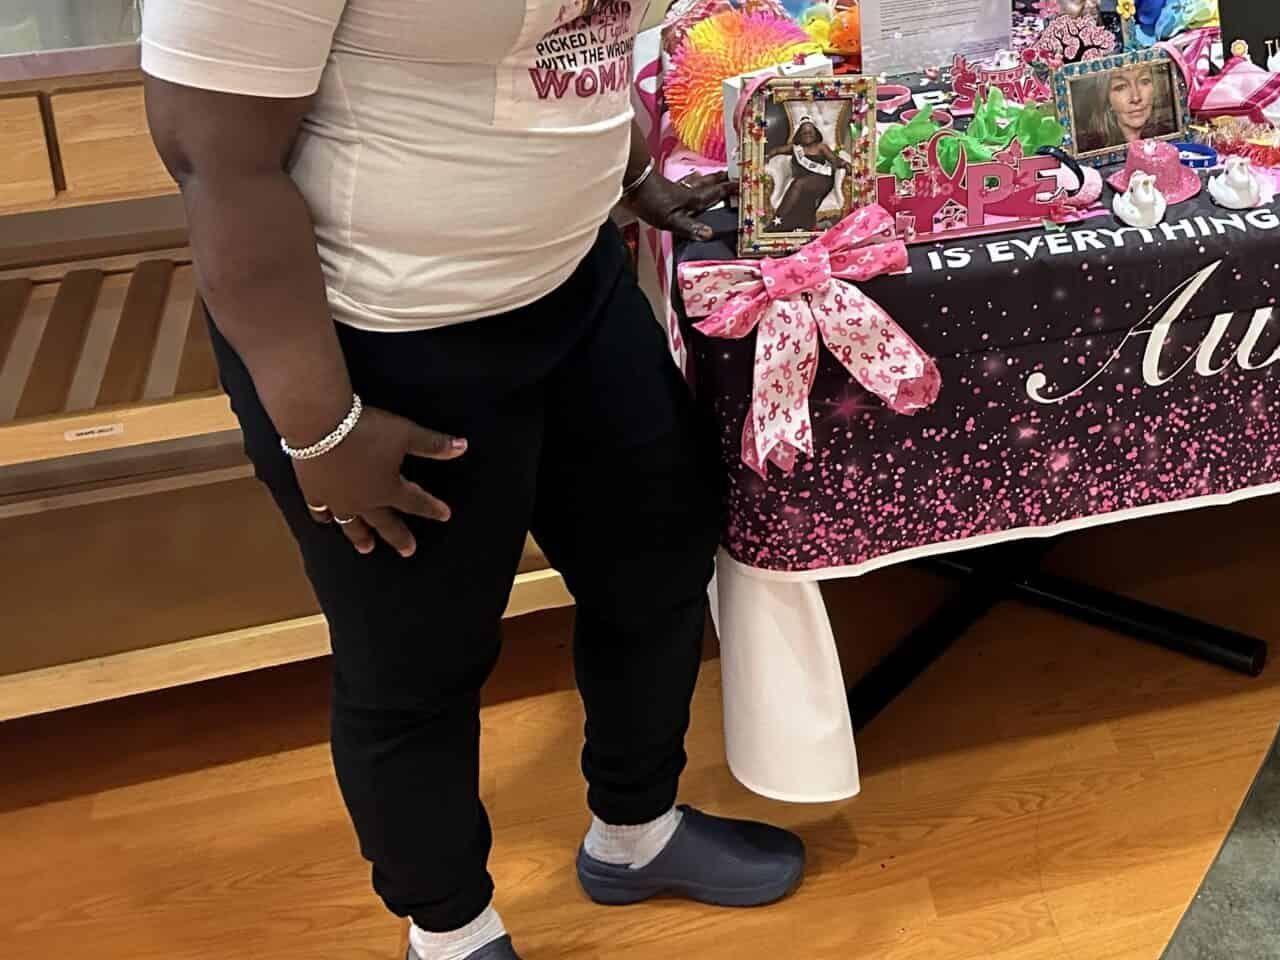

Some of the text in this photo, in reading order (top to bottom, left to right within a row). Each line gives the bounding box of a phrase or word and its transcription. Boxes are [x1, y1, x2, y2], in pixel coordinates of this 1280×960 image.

[535, 32, 588, 56] PICKED
[590, 31, 598, 45] A
[535, 52, 578, 70] WITH
[579, 46, 605, 65] THE
[927, 247, 972, 271] IS
